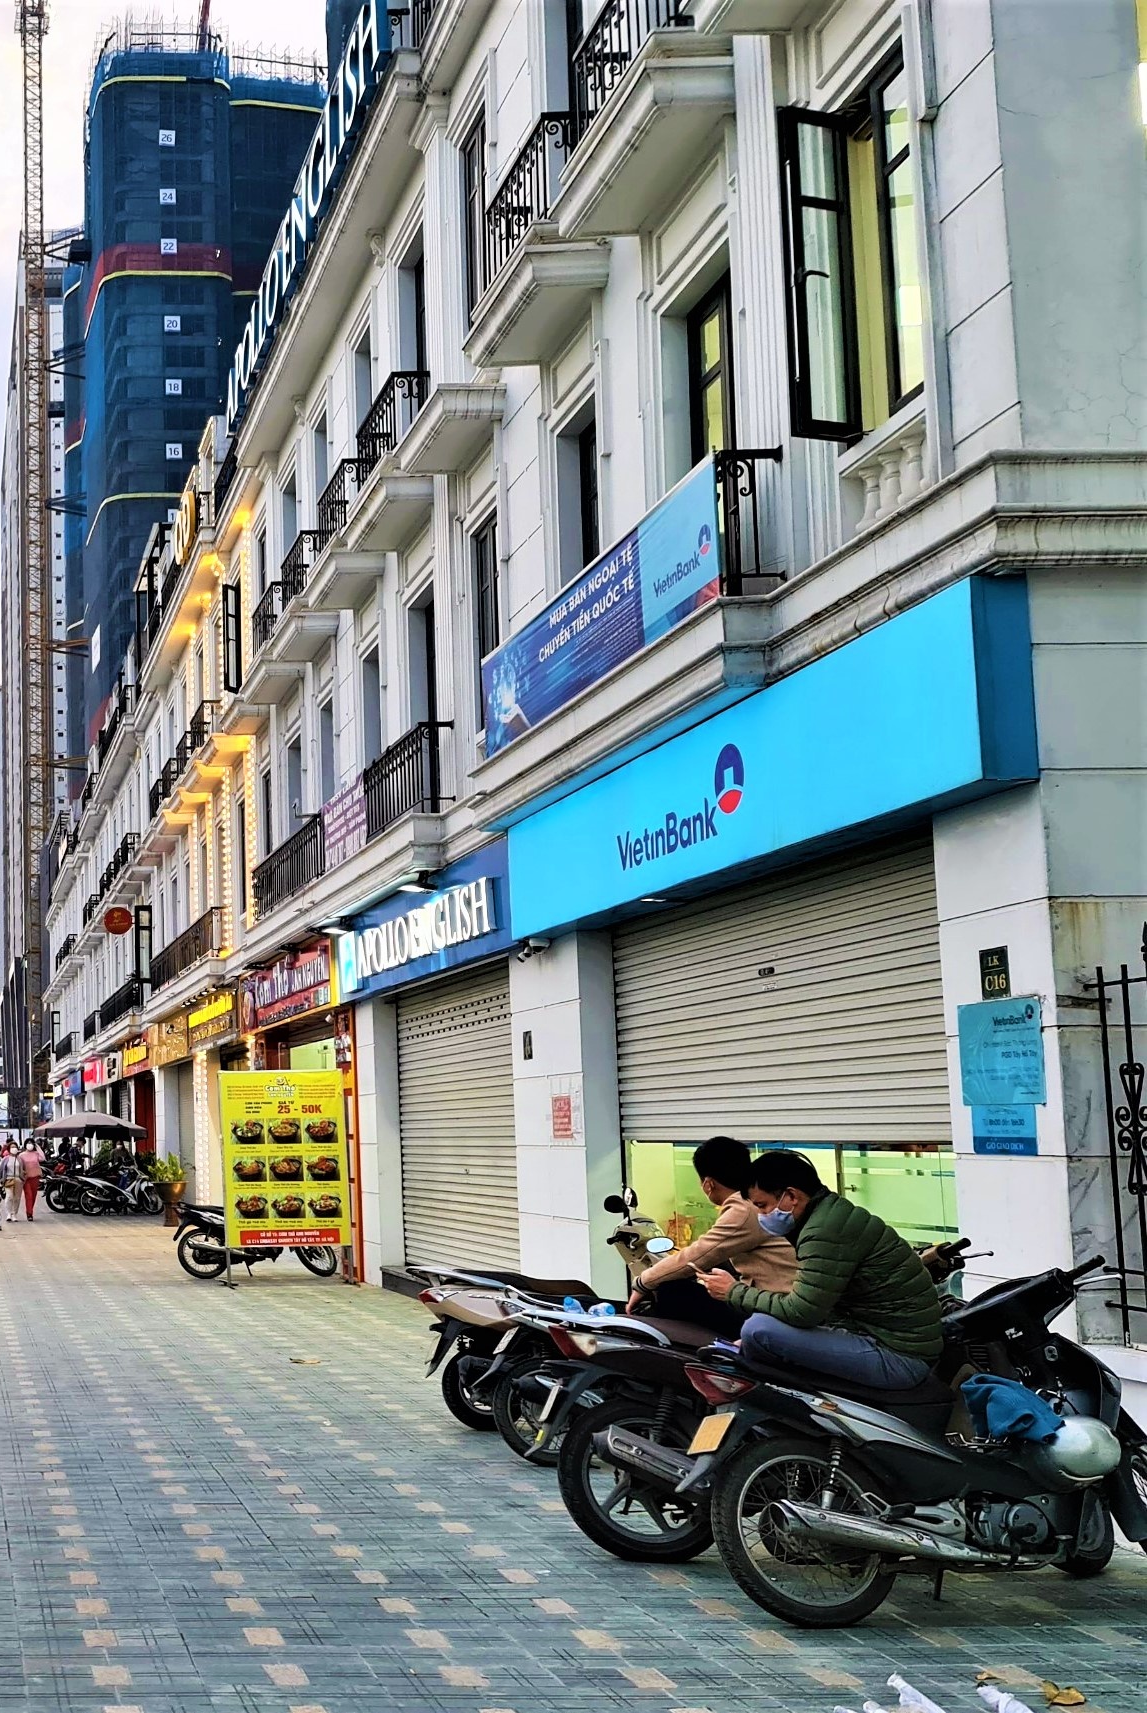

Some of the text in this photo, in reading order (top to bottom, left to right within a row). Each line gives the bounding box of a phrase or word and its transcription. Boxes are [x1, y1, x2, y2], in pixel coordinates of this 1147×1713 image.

[161, 133, 173, 143] 26
[162, 192, 174, 202] 24
[226, 0, 381, 438] APOLLO ENGLISH
[163, 242, 175, 252] 22
[166, 319, 179, 329] 20
[168, 383, 180, 392] 18
[168, 447, 180, 456] 16
[653, 552, 701, 598] VietinBank
[549, 541, 633, 628] MUA BÁN NGOẠI TỆ
[538, 624, 571, 662] CHUYỂN
[593, 584, 621, 619] QUỐC
[622, 565, 635, 594] TẾ
[616, 797, 718, 871] VietinBank
[356, 876, 492, 979] APOLLO ENGLISH
[988, 956, 1000, 967] LK
[984, 975, 1007, 992] C16
[277, 1105, 291, 1114] 25
[301, 1105, 323, 1114] 50K
